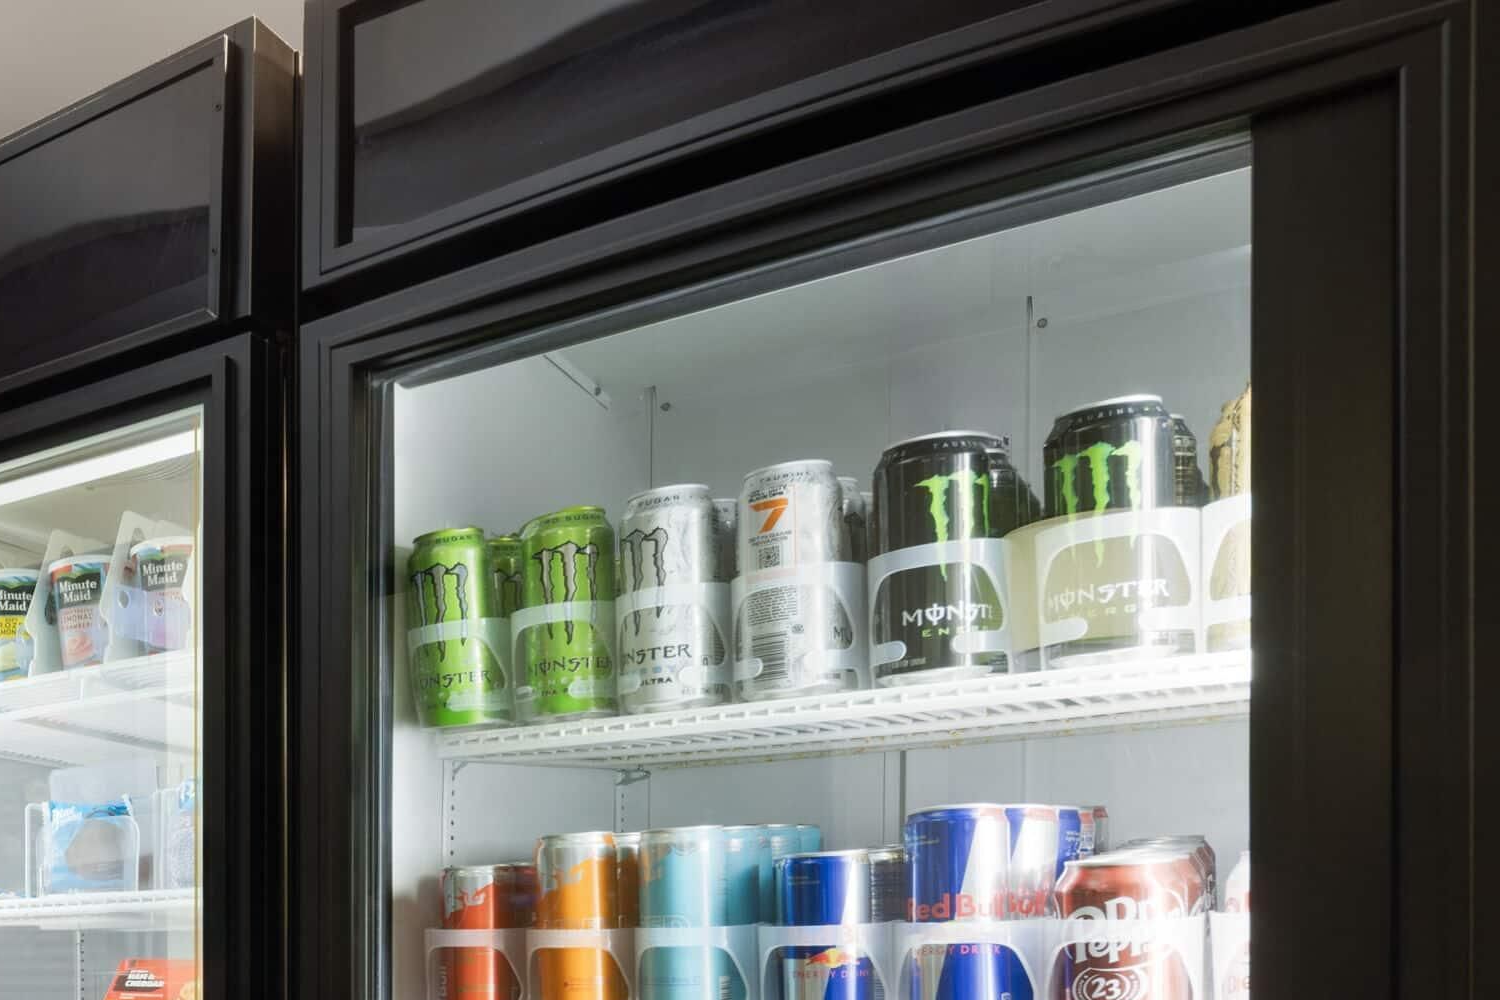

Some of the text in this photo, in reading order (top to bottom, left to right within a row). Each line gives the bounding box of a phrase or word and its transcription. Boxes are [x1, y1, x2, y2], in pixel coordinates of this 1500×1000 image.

[748, 497, 788, 535] 7
[142, 561, 184, 576] Minute
[60, 580, 98, 592] Minute
[148, 571, 178, 587] Maid
[63, 591, 92, 603] Maid
[622, 643, 692, 665] NSTER
[420, 670, 492, 690] ONSTER
[1091, 978, 1121, 1000] 23
